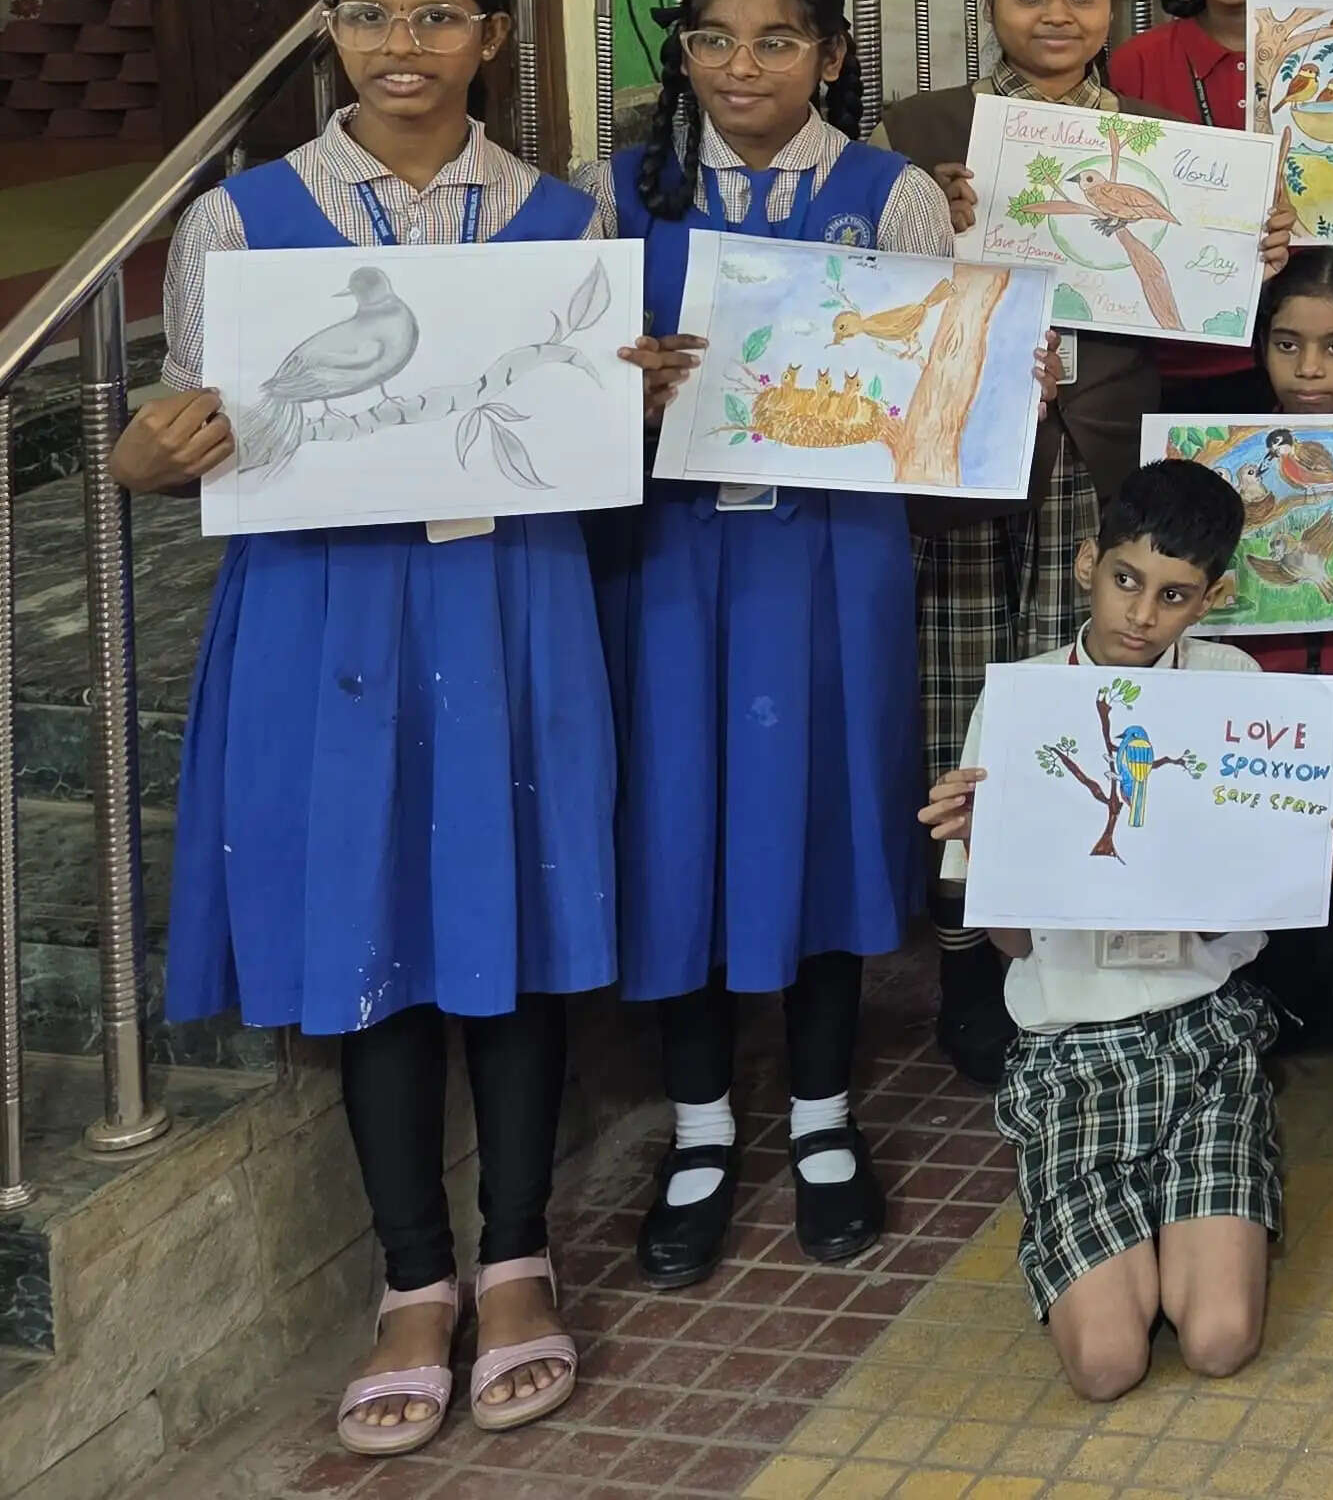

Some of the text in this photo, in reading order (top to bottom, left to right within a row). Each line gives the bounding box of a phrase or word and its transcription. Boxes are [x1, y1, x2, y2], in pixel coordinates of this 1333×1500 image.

[1004, 110, 1107, 148] Save Nature
[1173, 148, 1230, 188] World
[984, 224, 1015, 249] Save
[1185, 244, 1239, 284] Day
[1224, 718, 1307, 751] LOVE
